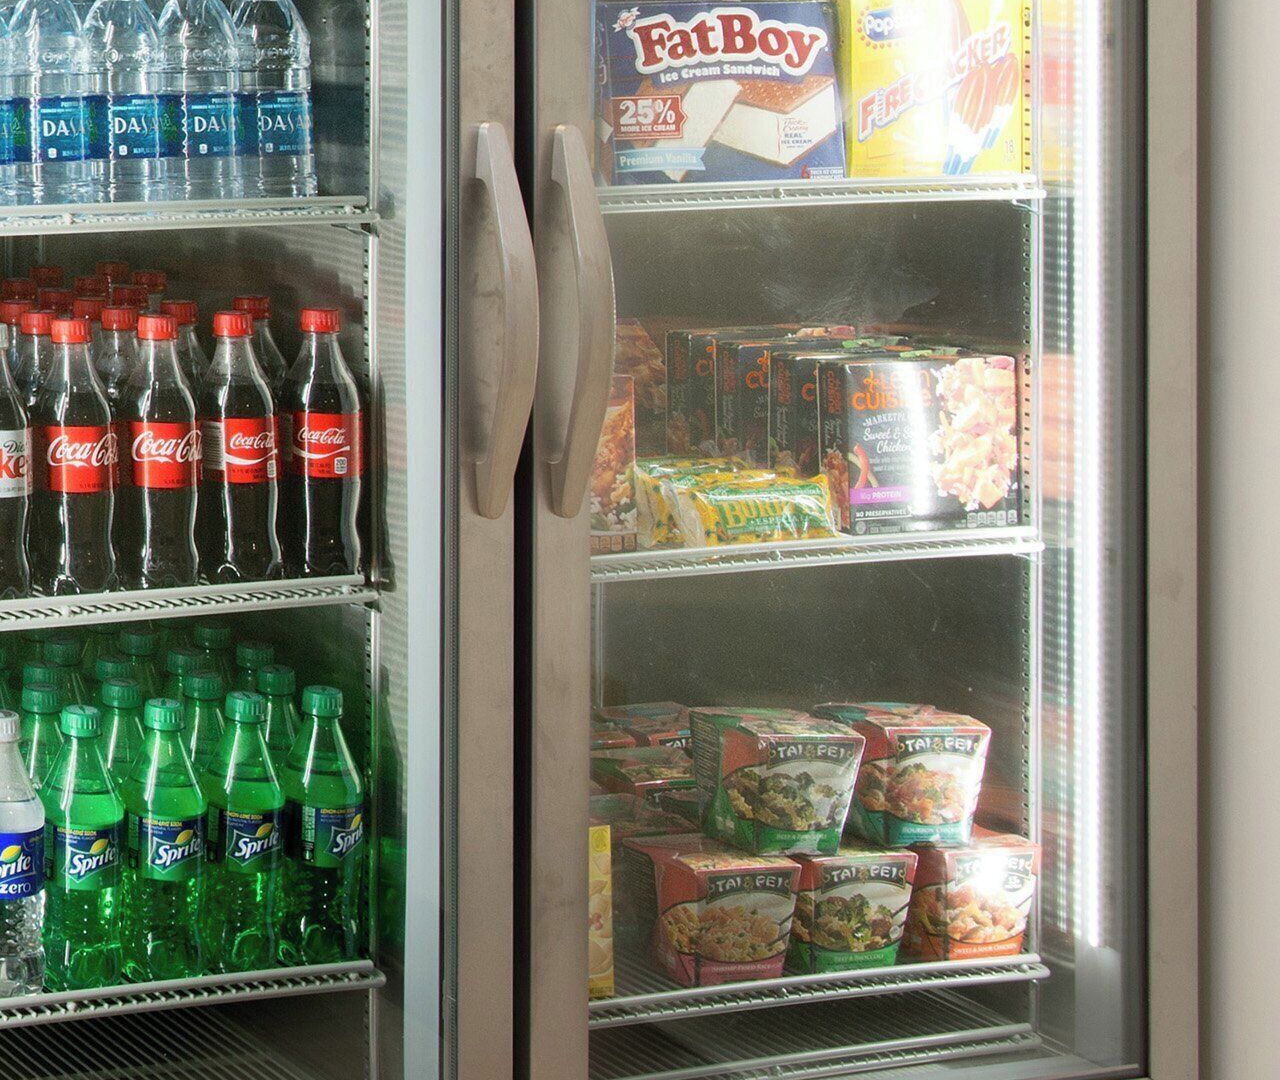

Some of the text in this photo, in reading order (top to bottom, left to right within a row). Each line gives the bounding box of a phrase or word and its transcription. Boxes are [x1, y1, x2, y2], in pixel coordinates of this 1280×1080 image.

[659, 64, 781, 83] Ice Cream Sandwich
[619, 99, 676, 125] 25%
[619, 154, 664, 168] Premium
[298, 426, 346, 445] Coca-Cola
[906, 737, 973, 751] TAI PEI
[154, 836, 203, 865] Sprite
[234, 833, 281, 860] Sprite
[69, 847, 118, 877] Sprite
[831, 866, 898, 881] TAI PEI
[717, 875, 783, 893] TAI PEI
